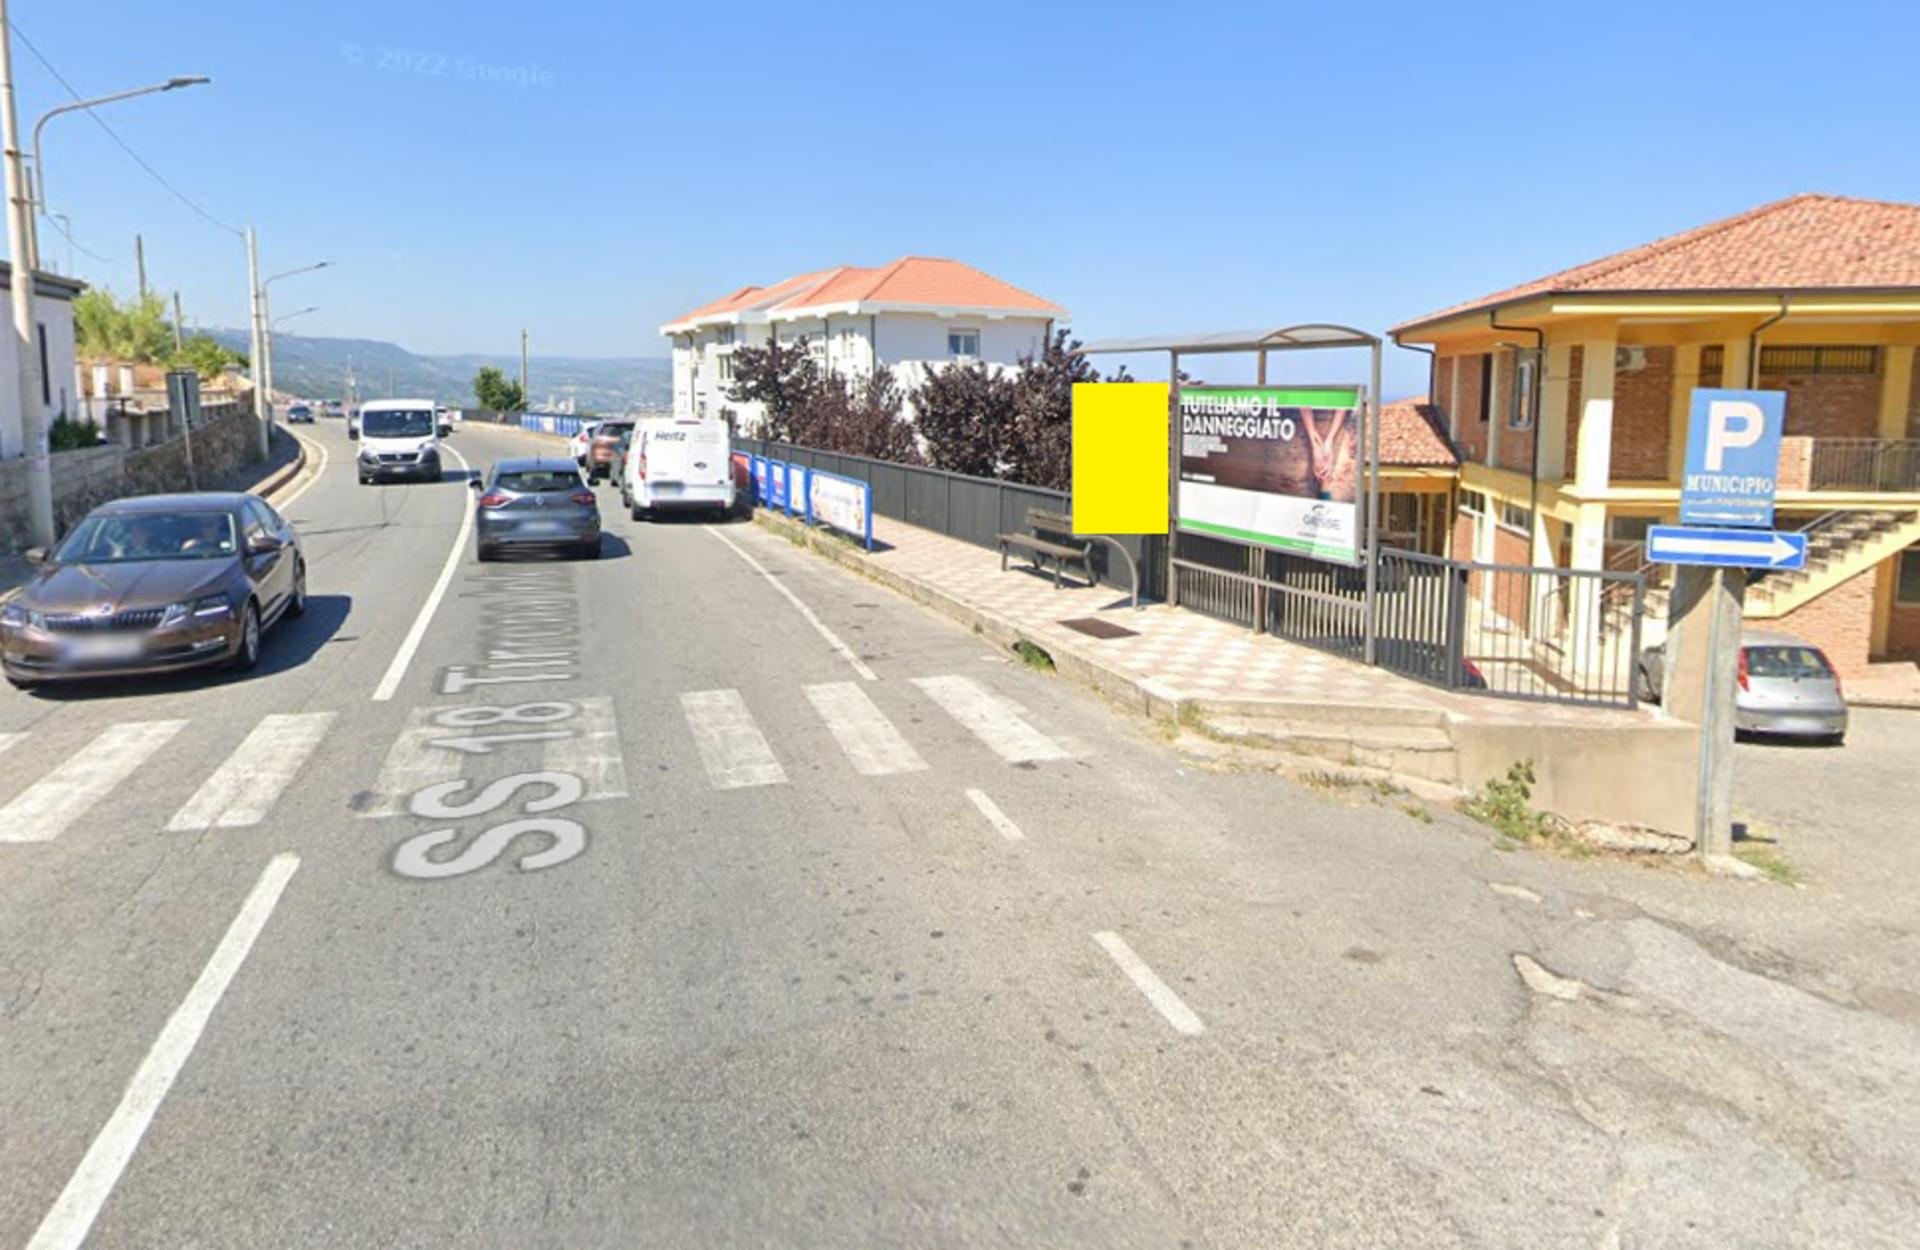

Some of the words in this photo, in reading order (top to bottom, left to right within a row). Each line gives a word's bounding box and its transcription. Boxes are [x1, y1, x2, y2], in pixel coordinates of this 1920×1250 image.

[1182, 395, 1262, 417] TUTELIAMO
[1266, 397, 1280, 417] IL
[655, 430, 687, 441] Hertz
[1182, 416, 1295, 441] DANNEGGIATO
[1704, 400, 1764, 471] P
